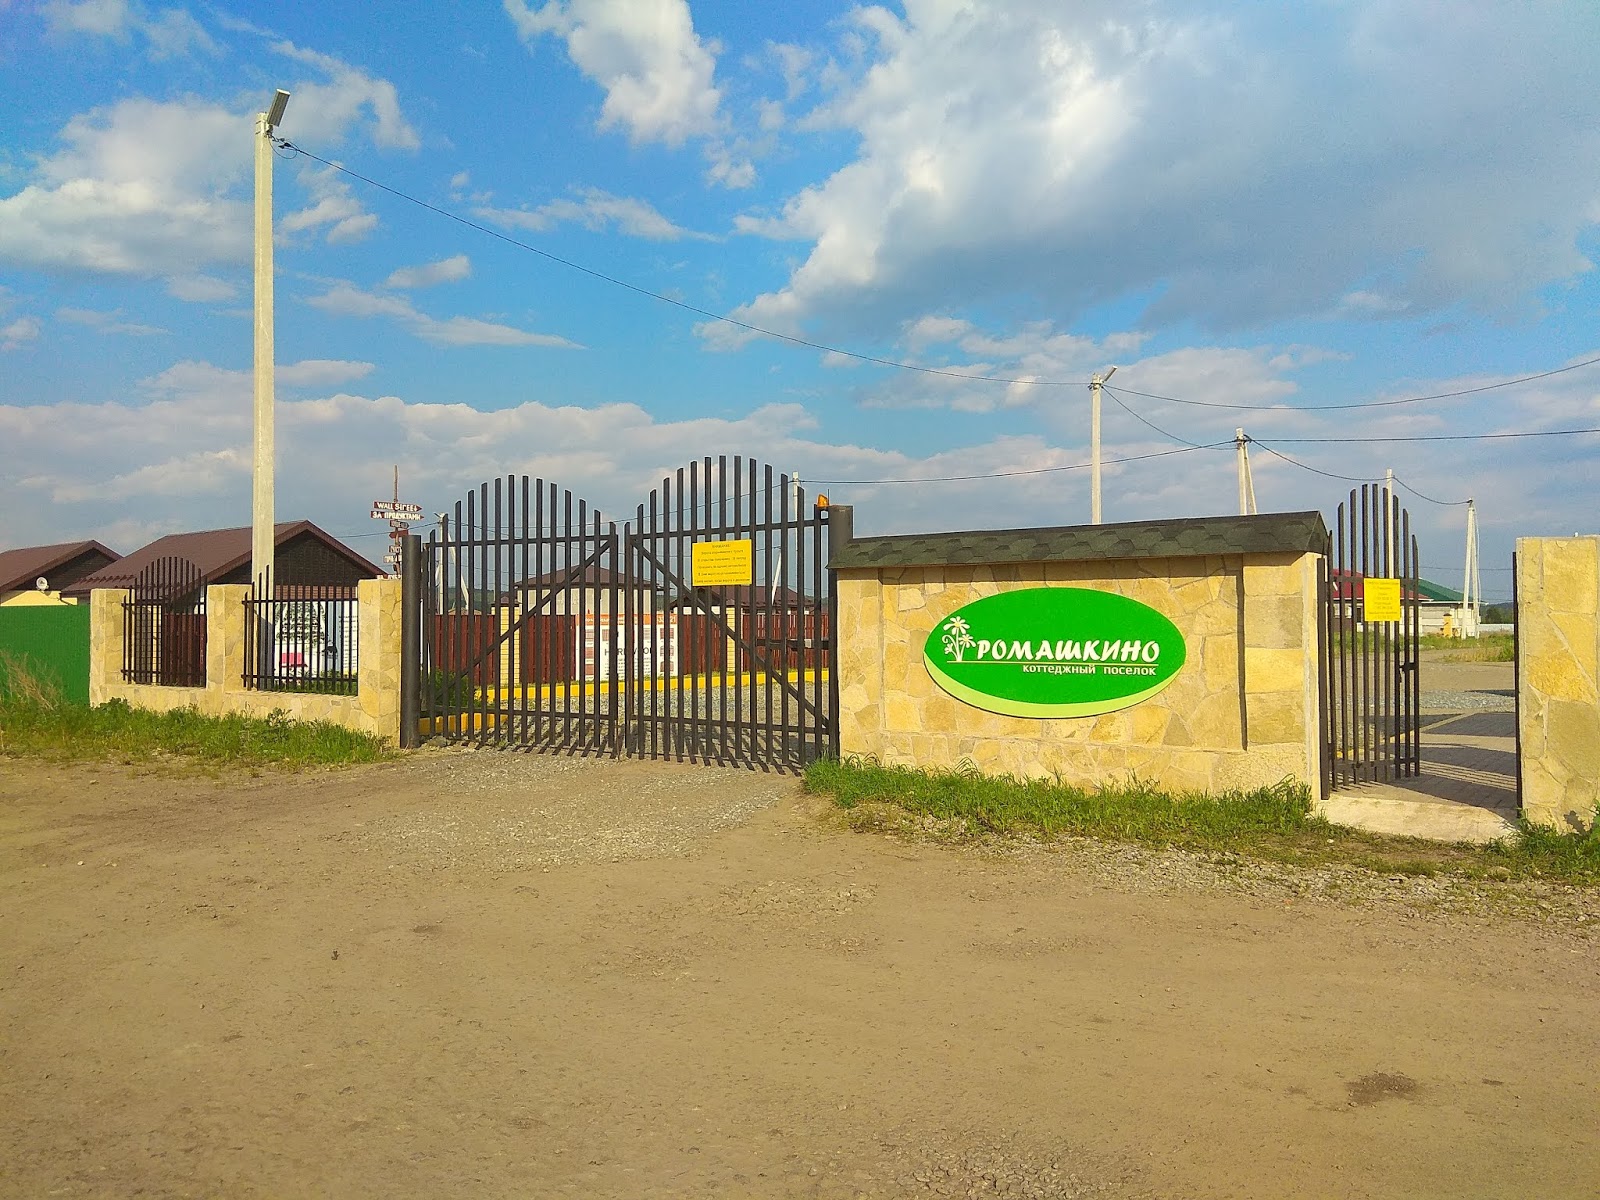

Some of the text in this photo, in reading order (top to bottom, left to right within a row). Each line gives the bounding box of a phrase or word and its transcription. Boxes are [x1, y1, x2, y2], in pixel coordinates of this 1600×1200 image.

[377, 502, 393, 510] WALL
[373, 511, 382, 519] ЗА
[977, 640, 1160, 662] РОМАШКИНО
[1023, 664, 1157, 676] коттеджный поселок
